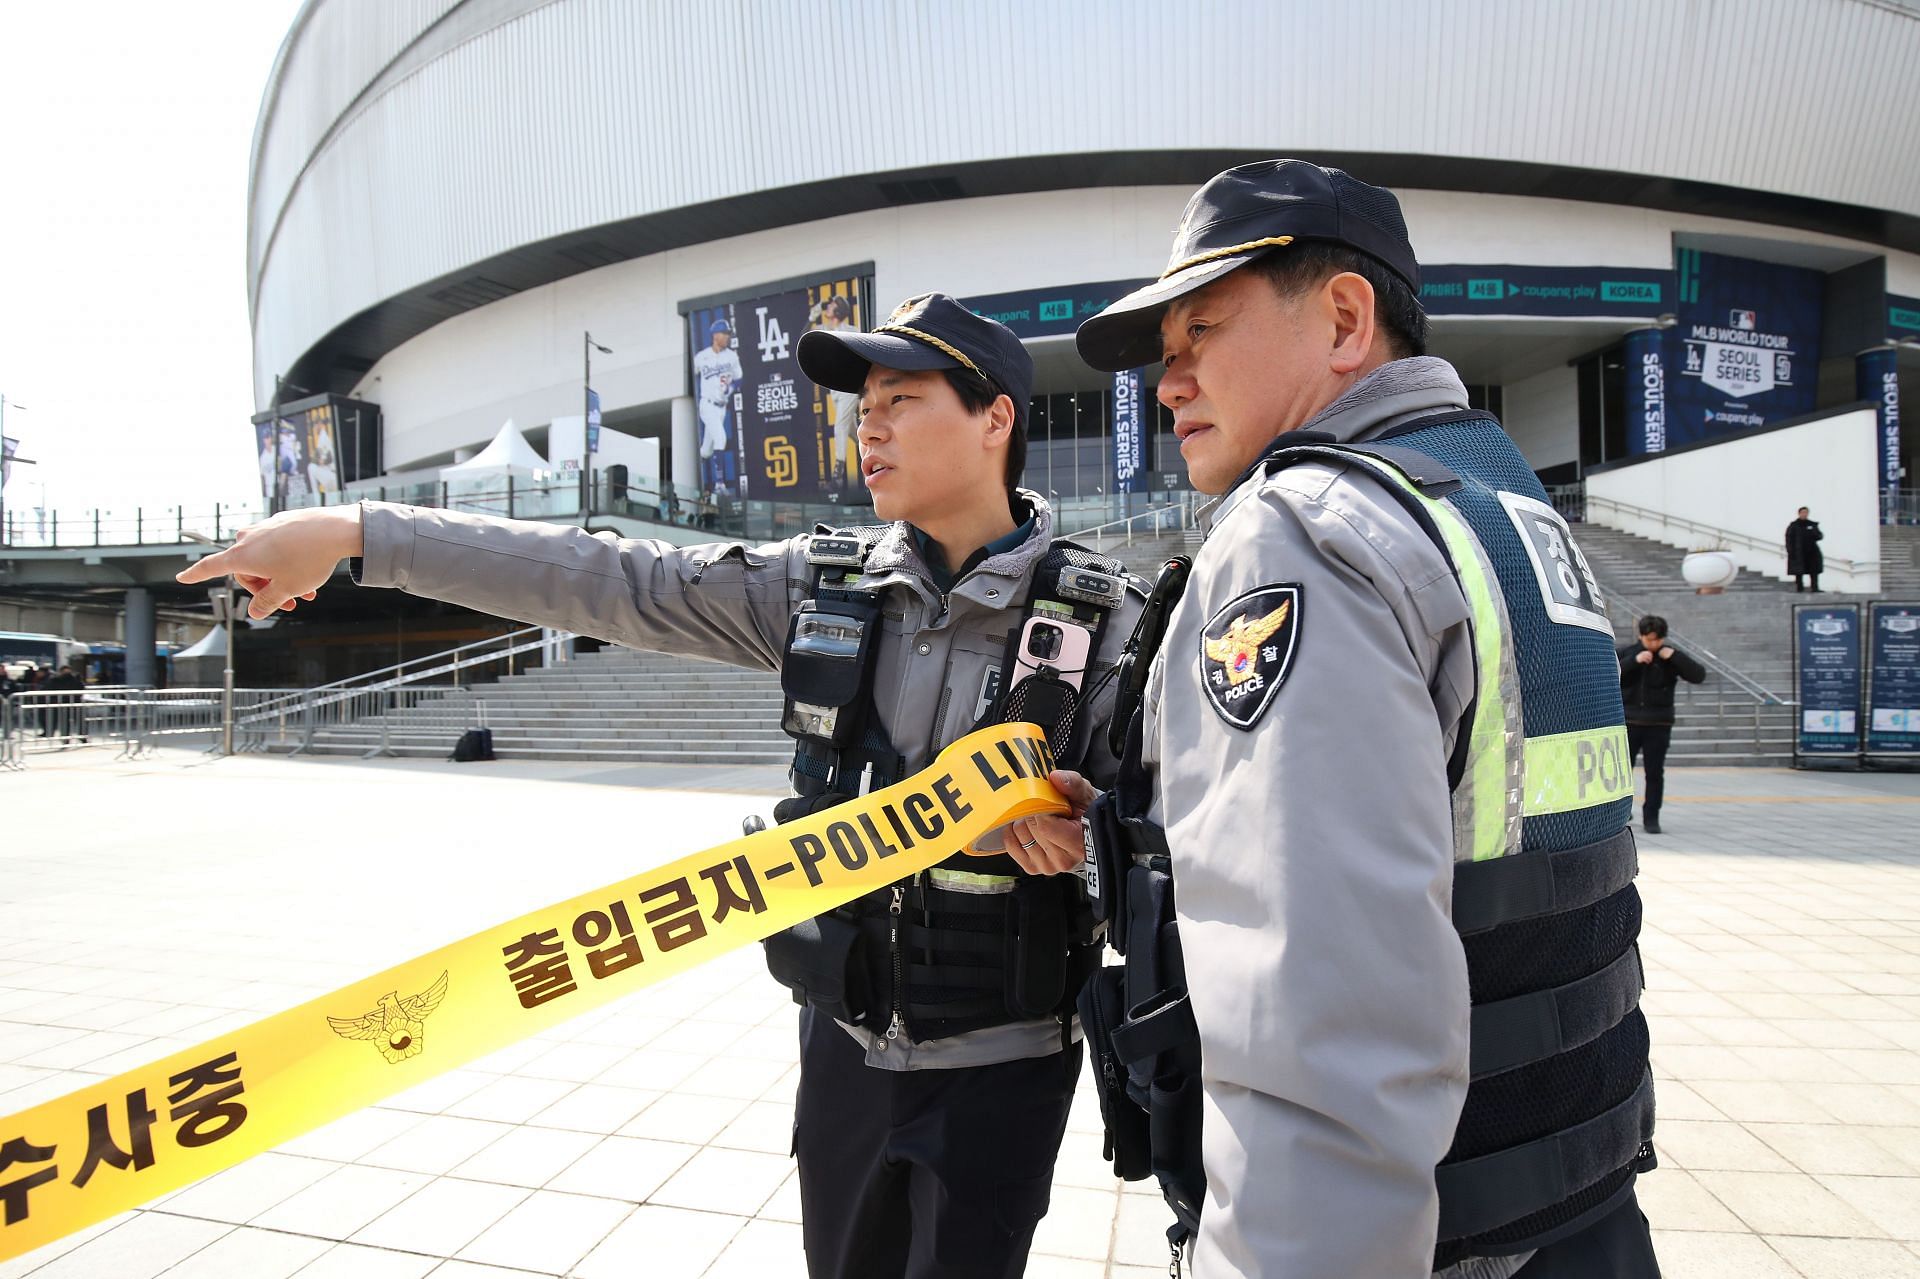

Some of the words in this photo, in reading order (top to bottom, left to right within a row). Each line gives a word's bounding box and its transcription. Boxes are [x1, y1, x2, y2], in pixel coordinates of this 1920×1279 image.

[1523, 284, 1571, 298] coupang
[1573, 284, 1597, 299] play
[1609, 282, 1654, 299] KOREA
[1045, 303, 1068, 316] 서울
[755, 306, 789, 362] LA
[1692, 325, 1717, 340] MLB
[1717, 328, 1758, 344] WORLD
[1759, 333, 1789, 348] TOUR
[1686, 343, 1701, 371] LA
[1719, 349, 1761, 366] SEOUL
[1643, 353, 1660, 410] SEOUL
[1716, 365, 1762, 383] SERIES
[757, 385, 797, 401] SEOUL
[757, 397, 799, 414] SERIES
[1130, 389, 1138, 409] MLB
[1883, 373, 1898, 424] SEOUL
[1130, 410, 1139, 444] WORLD
[1645, 410, 1661, 453] SERI
[764, 435, 798, 488] SD
[1116, 421, 1131, 480] SERIES
[1885, 425, 1900, 481] SERIES
[1211, 669, 1224, 685] 경
[1262, 645, 1279, 663] 찰
[1225, 675, 1264, 703] POLICE
[1577, 734, 1632, 800] POLI
[0, 1051, 248, 1226] 수사중
